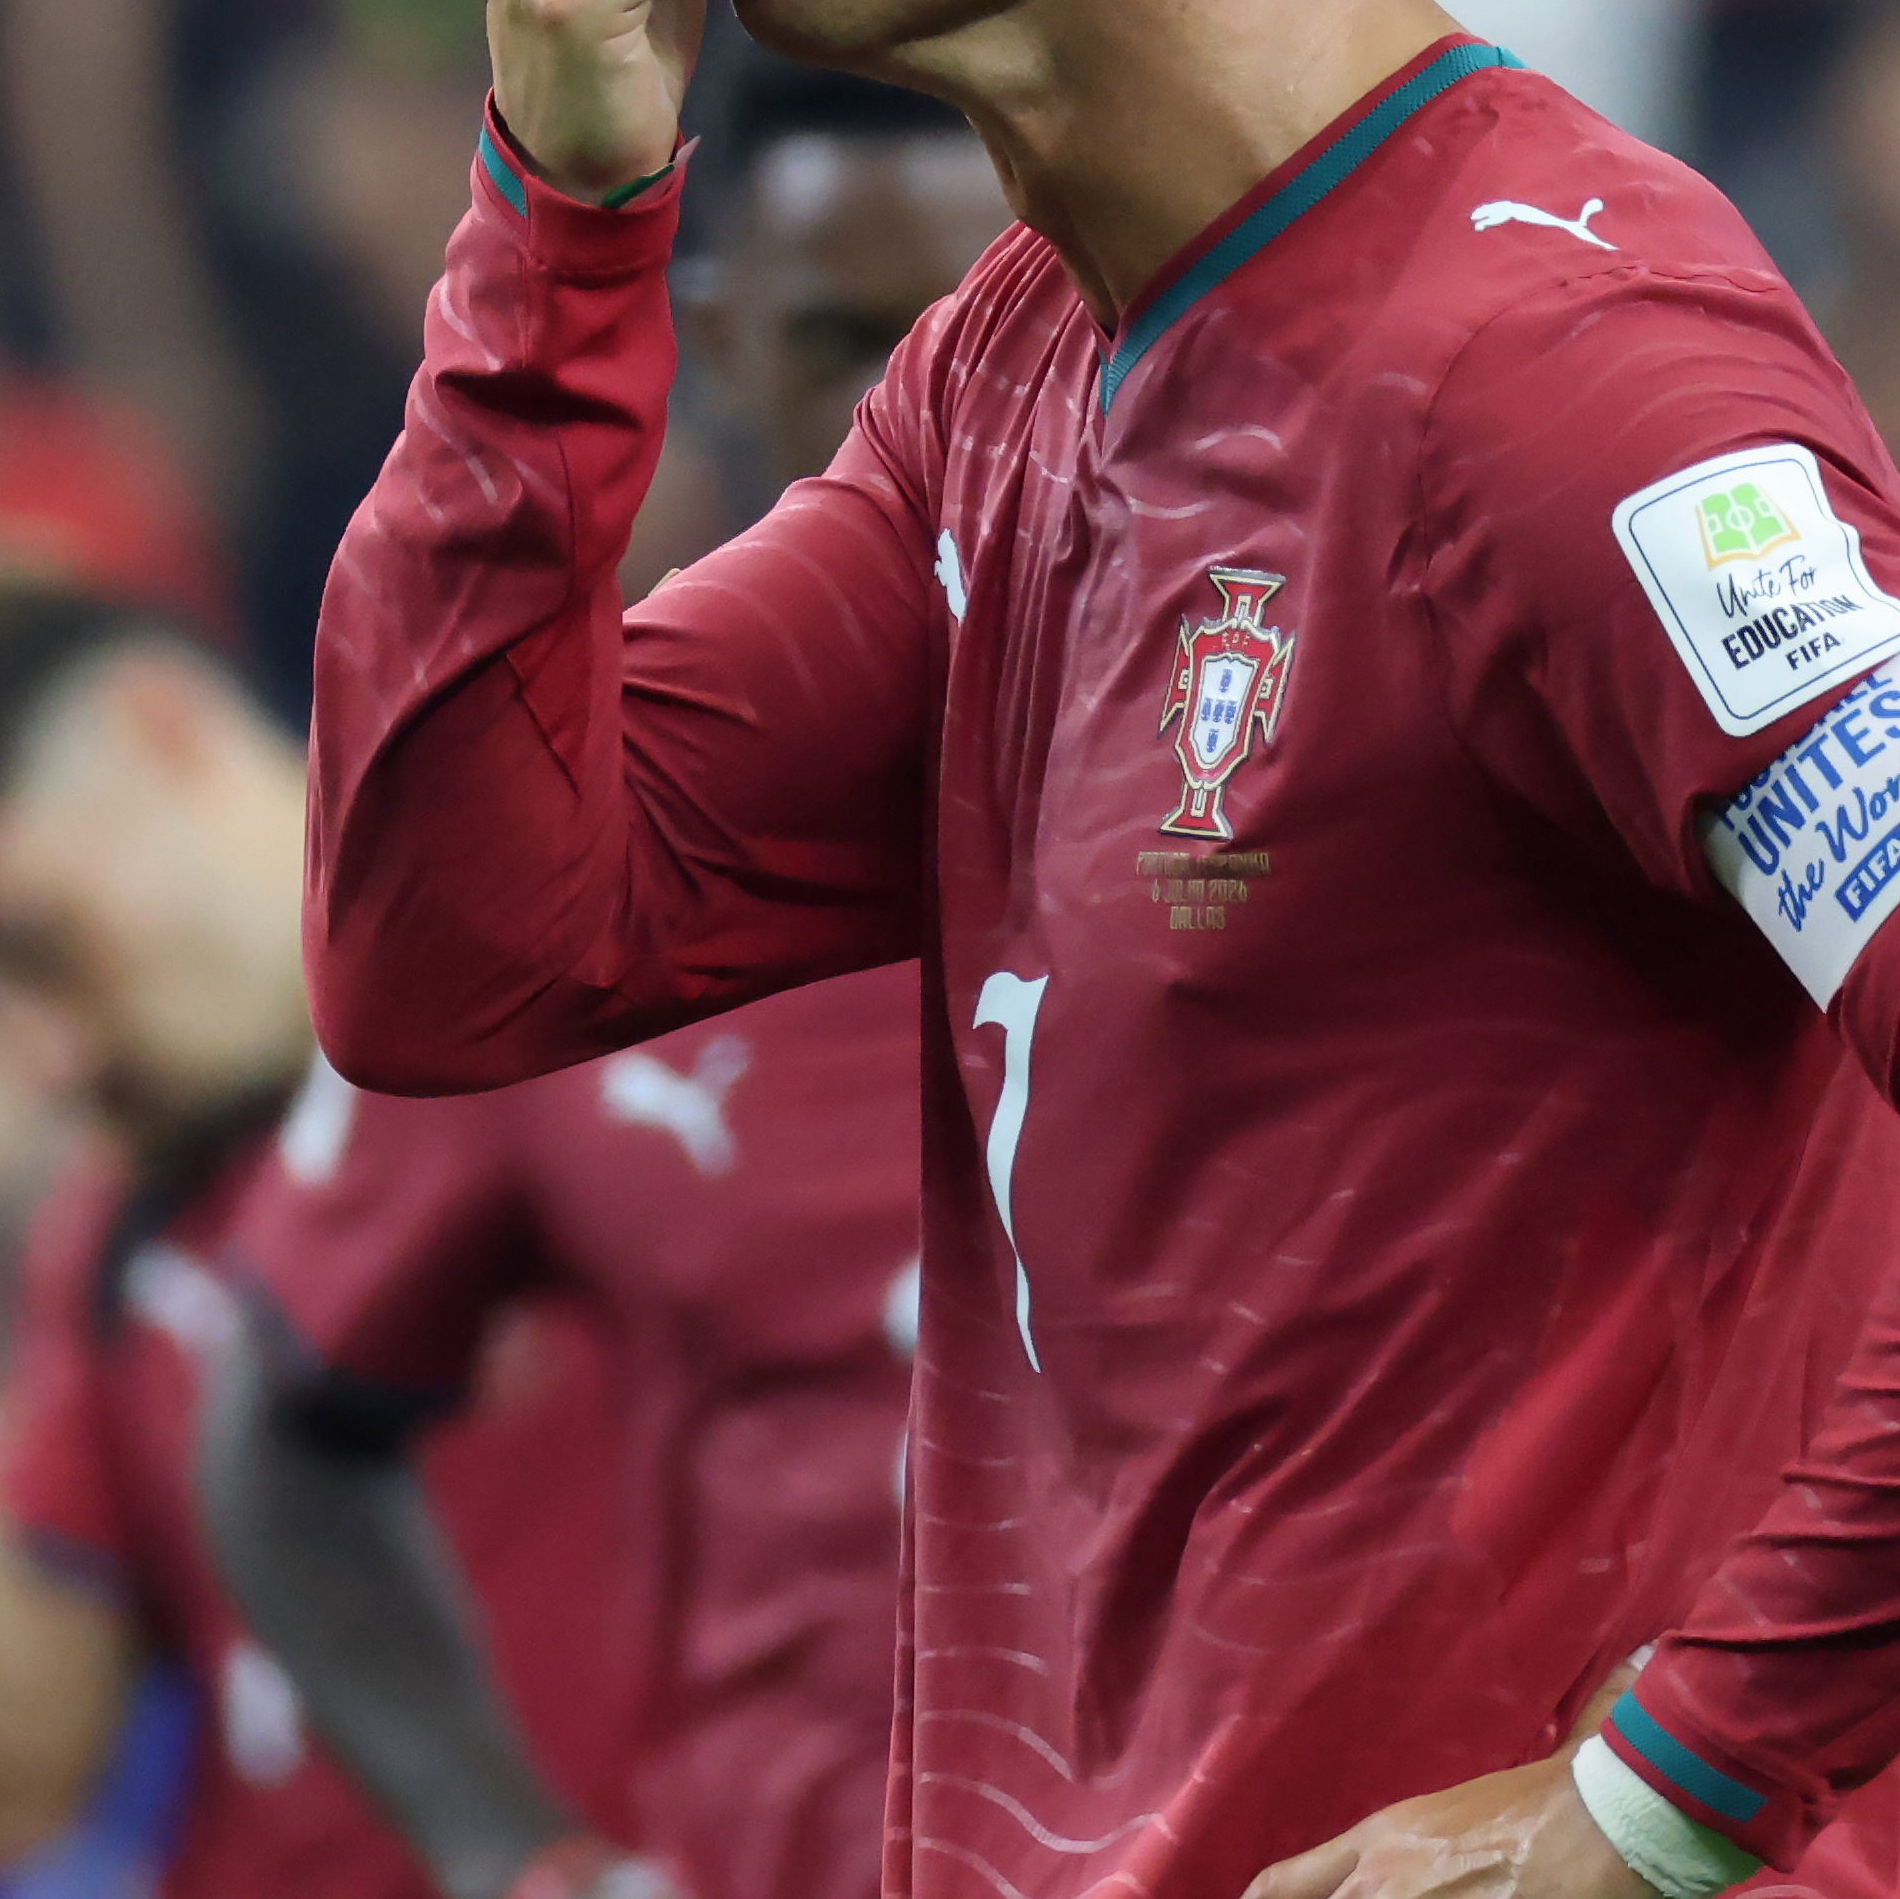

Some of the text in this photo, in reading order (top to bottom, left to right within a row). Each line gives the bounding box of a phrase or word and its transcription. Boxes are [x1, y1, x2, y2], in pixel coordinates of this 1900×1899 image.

[1716, 554, 1817, 618] Unite For
[1720, 594, 1865, 670] EDUCATION
[1785, 632, 1842, 671] FIFA
[1777, 858, 1825, 932] the
[973, 971, 1049, 1374] 7
